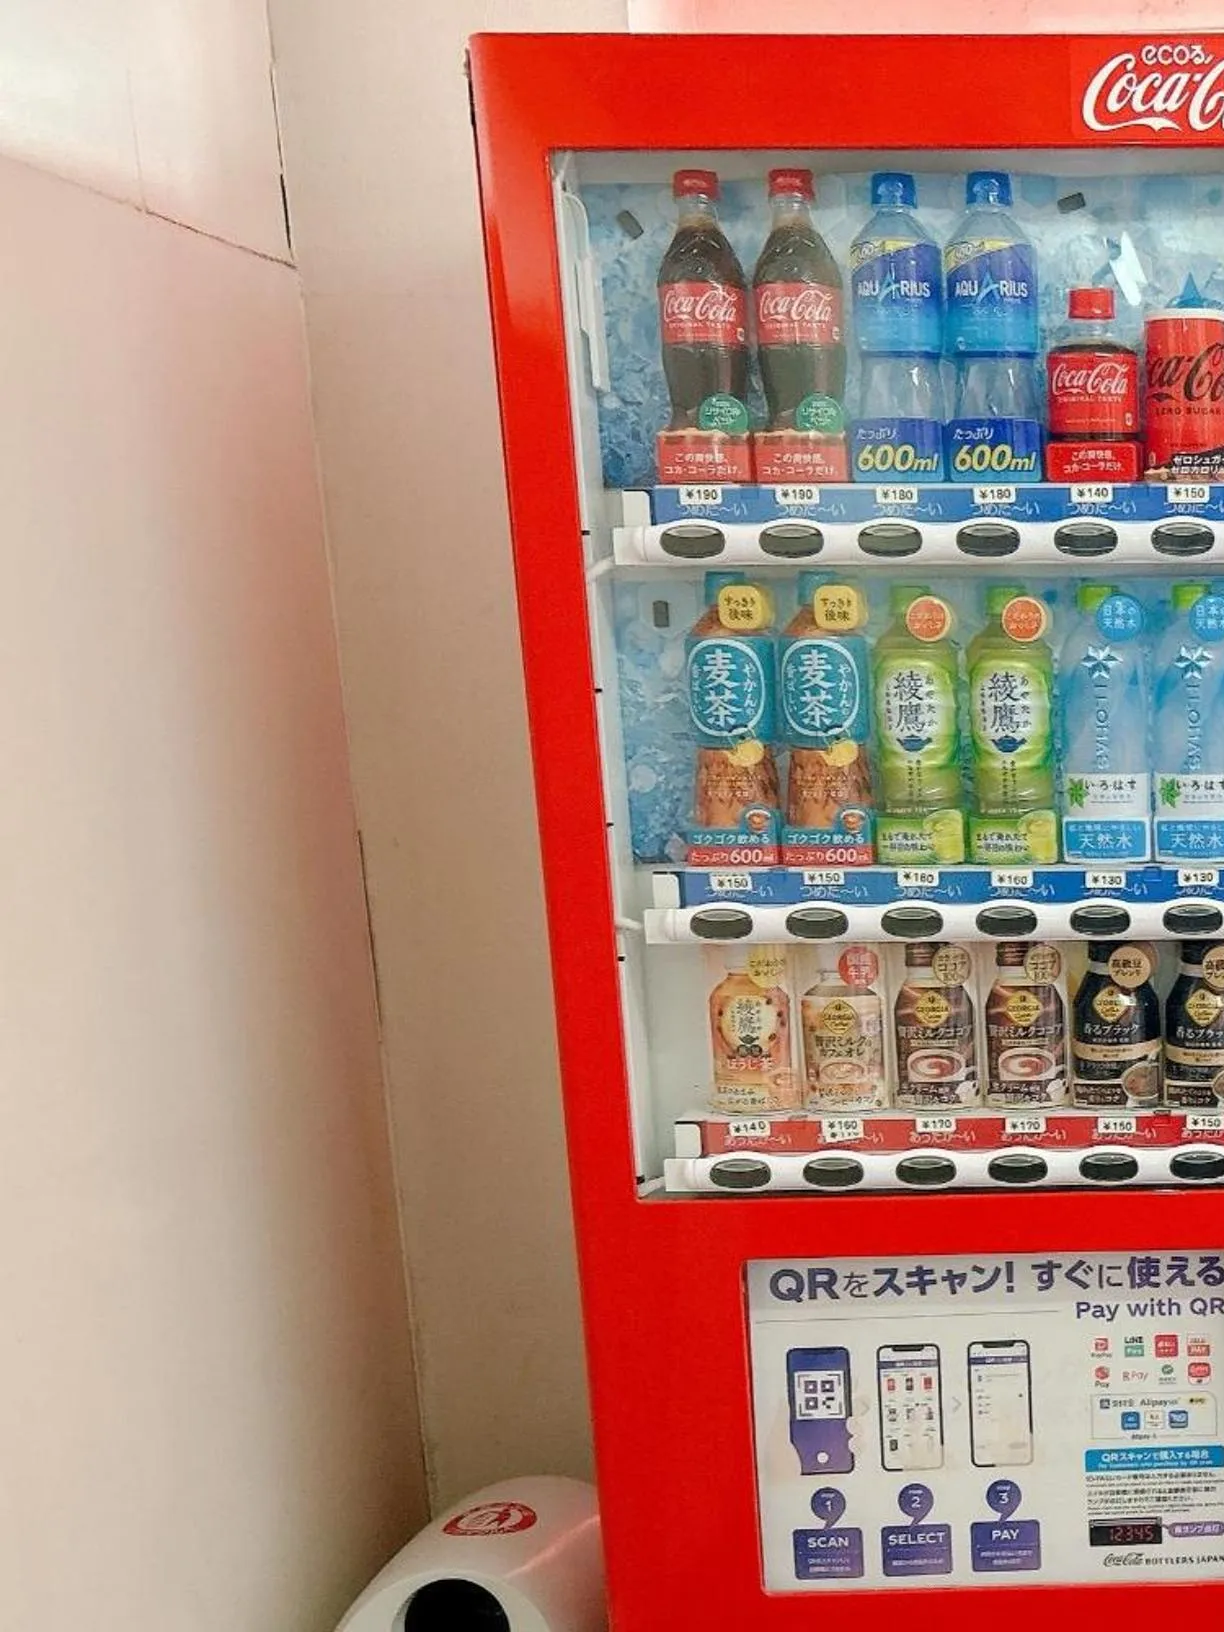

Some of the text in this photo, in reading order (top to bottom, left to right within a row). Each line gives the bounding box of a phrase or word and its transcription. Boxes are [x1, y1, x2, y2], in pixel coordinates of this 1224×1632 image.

[664, 286, 737, 322] Coca-Cola
[759, 286, 832, 322] Coca-Cola
[1052, 362, 1130, 396] Coca-Cola
[856, 428, 897, 440] たっぷり
[952, 428, 993, 440] たっぷり
[857, 444, 939, 472] 600ml
[953, 444, 1035, 472] 600ml
[1077, 488, 1109, 498] ¥140
[702, 650, 738, 725] 麦茶
[798, 650, 834, 725] 麦茶
[894, 671, 924, 731] 綾鷹
[988, 671, 1019, 732] 綾鷹
[693, 834, 770, 844] ゴクゴク飲める
[788, 834, 865, 844] ゴクゴク飲める
[1079, 832, 1133, 849] 天然水
[1170, 832, 1224, 849] 天然水
[808, 873, 839, 884] ¥150
[1092, 875, 1122, 886] ¥130
[1183, 872, 1214, 883] ¥130
[1192, 1117, 1220, 1127] ¥150
[769, 1262, 1015, 1303] QRをスキャン!
[1076, 1301, 1120, 1322] Pay
[1127, 1298, 1181, 1317] with
[912, 1497, 921, 1508] 2
[1000, 1492, 1009, 1504] 3
[826, 1500, 832, 1512] 1
[888, 1532, 945, 1546] SELECT
[992, 1529, 1020, 1540] PAY
[807, 1536, 848, 1548] SCAN
